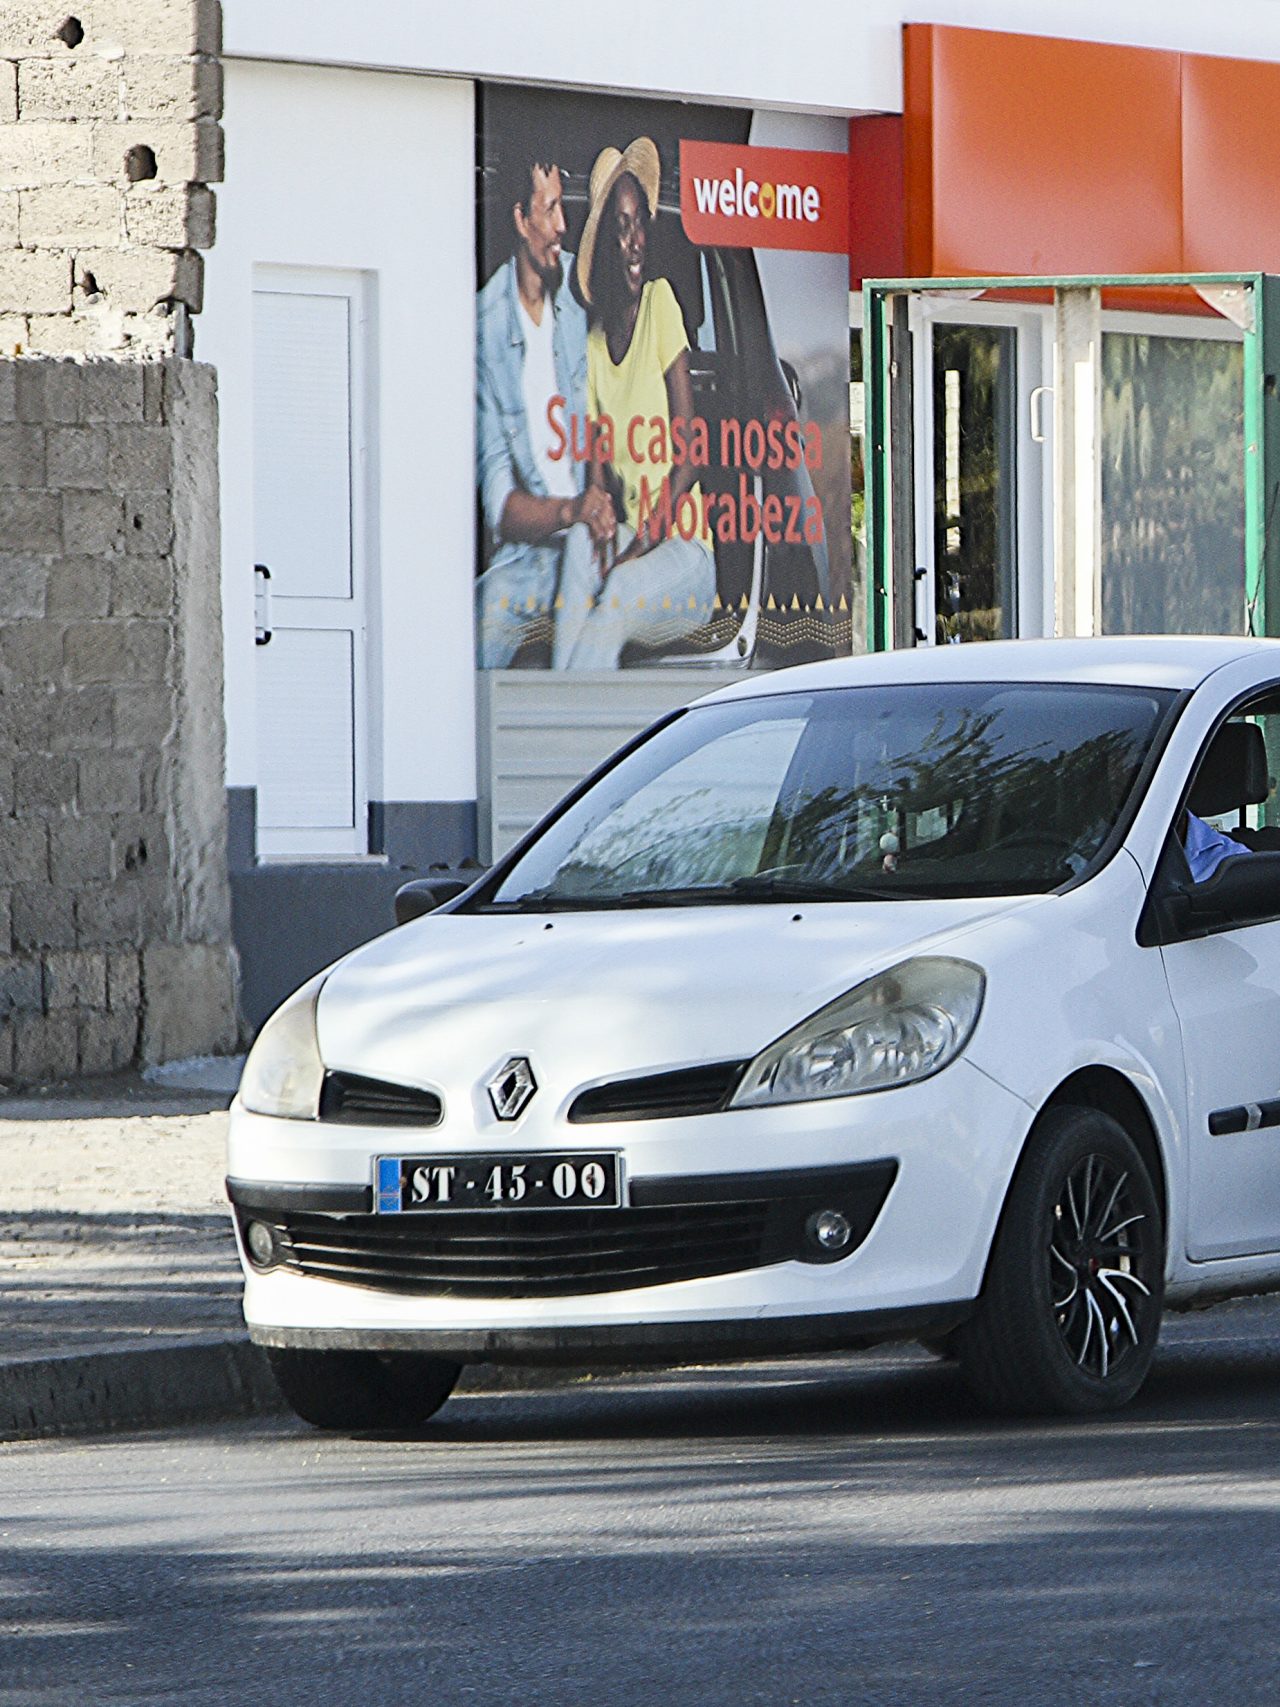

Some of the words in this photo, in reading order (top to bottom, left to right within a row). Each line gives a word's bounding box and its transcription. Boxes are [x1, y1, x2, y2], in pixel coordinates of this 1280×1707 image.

[693, 167, 820, 222] welcome
[547, 394, 614, 462] Sua
[627, 415, 710, 468] casa
[720, 418, 823, 470] nossa
[637, 472, 823, 544] Morabeza
